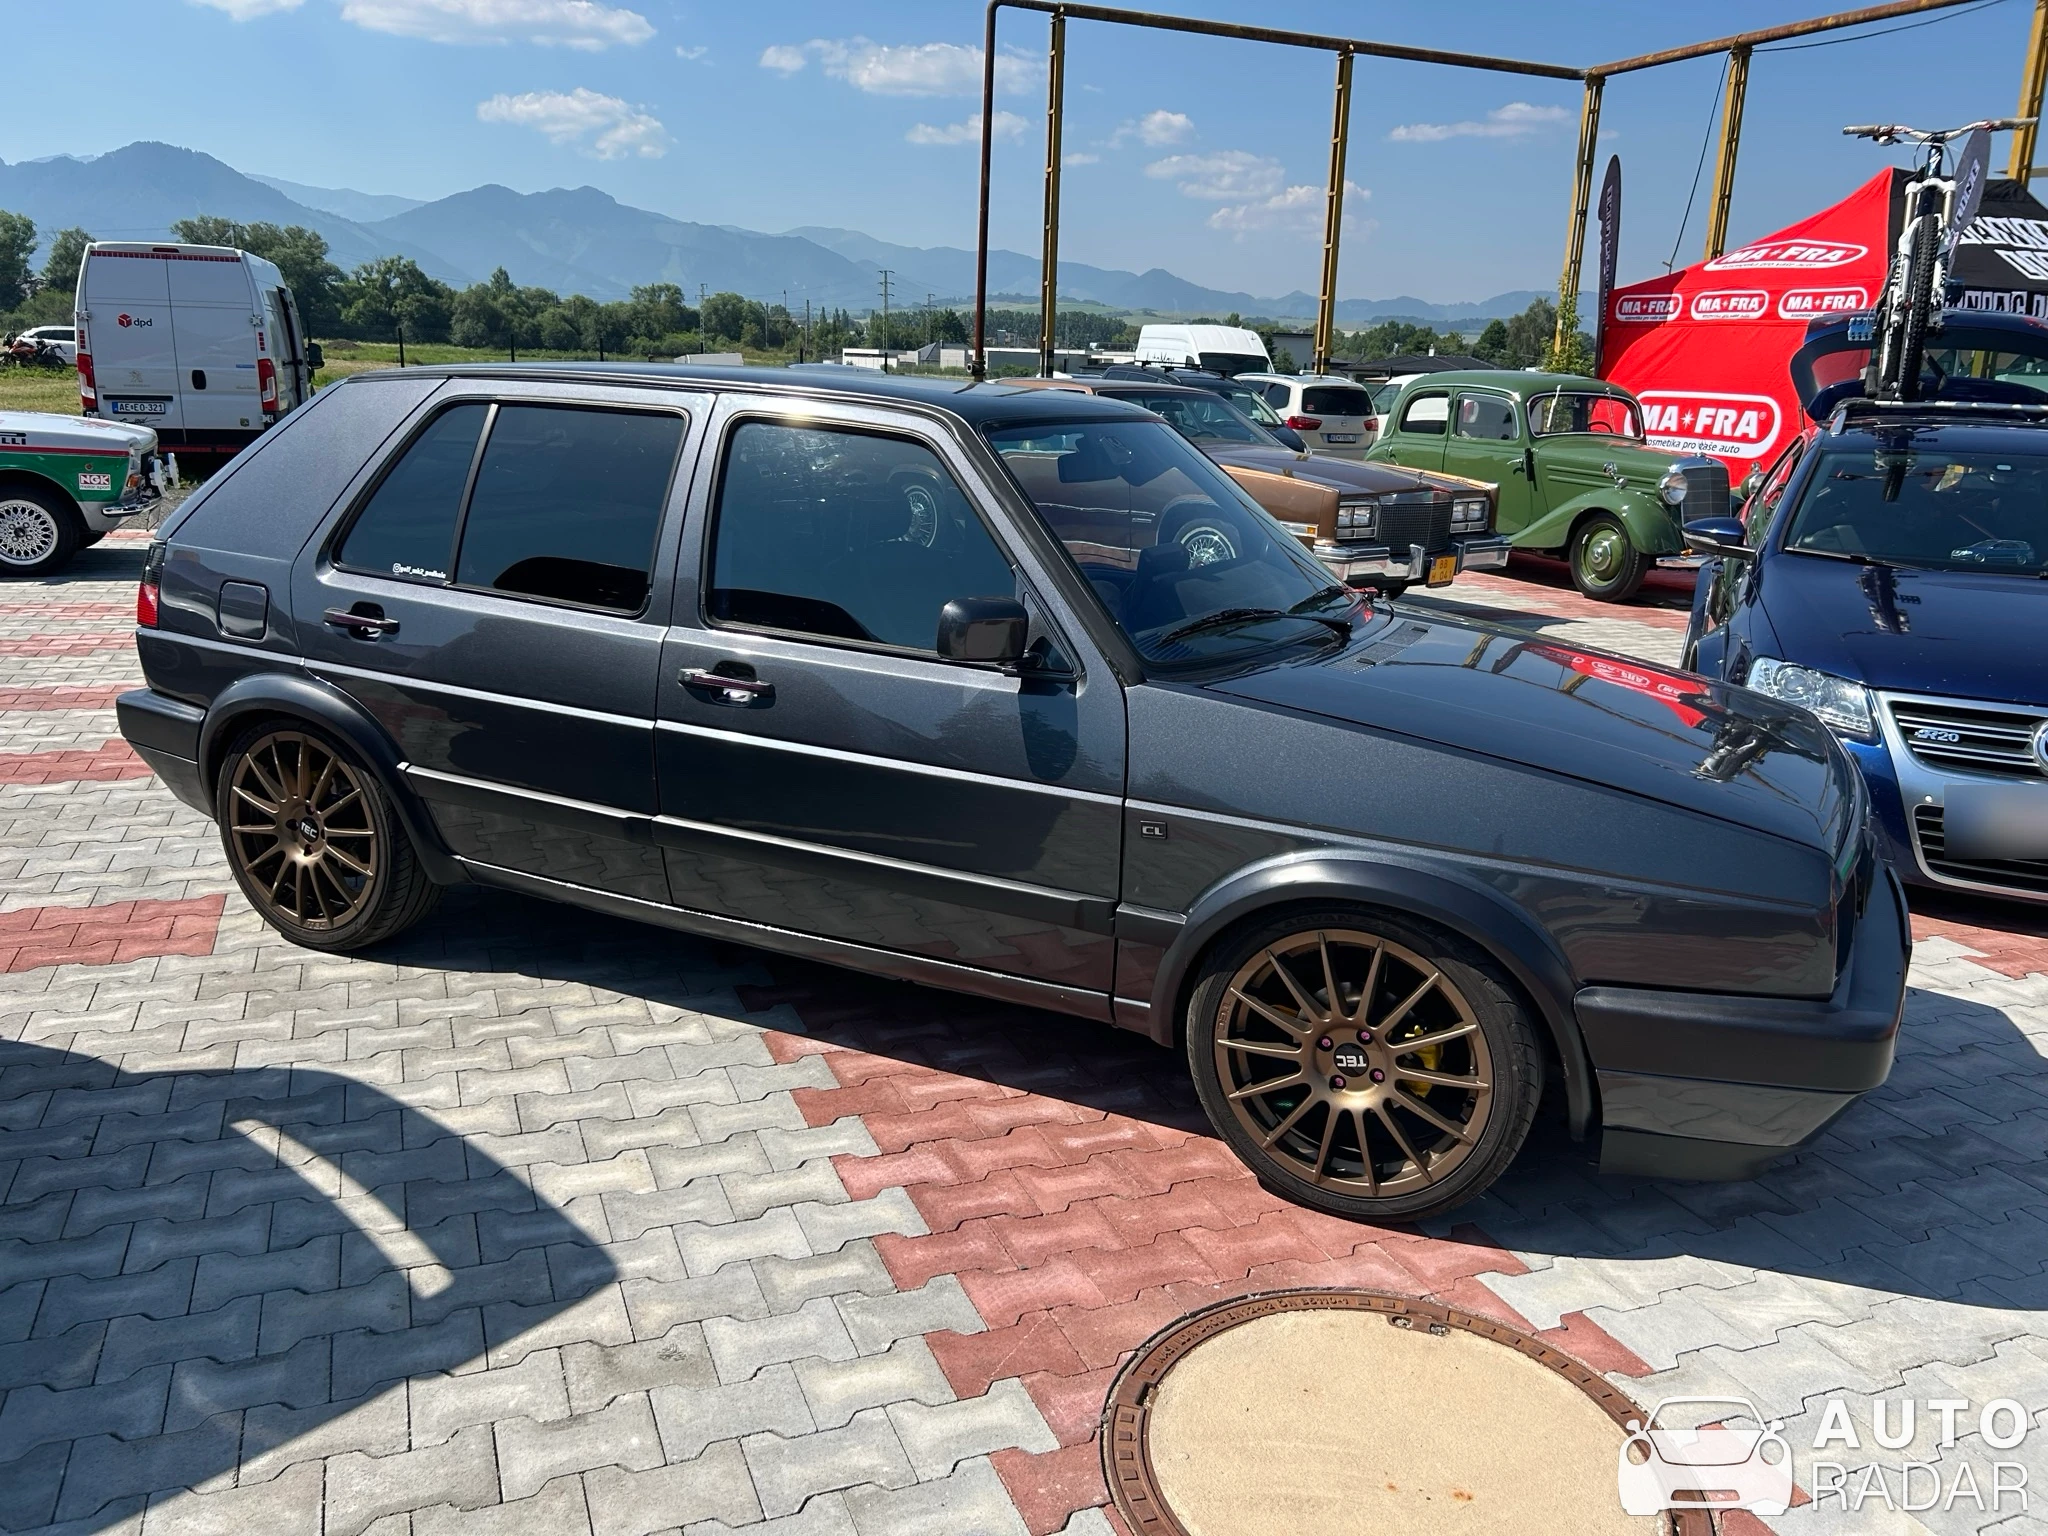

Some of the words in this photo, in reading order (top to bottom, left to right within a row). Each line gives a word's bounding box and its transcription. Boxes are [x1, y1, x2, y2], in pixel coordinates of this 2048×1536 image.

[133, 317, 153, 328] dpd
[1, 436, 26, 445] LLI
[1646, 438, 1681, 448] osmetika
[1681, 442, 1696, 450] pro
[1718, 444, 1740, 454] auto
[80, 475, 109, 485] NGK
[300, 821, 318, 839] TEC
[1142, 825, 1163, 836] CL
[1336, 1055, 1367, 1067] TEC
